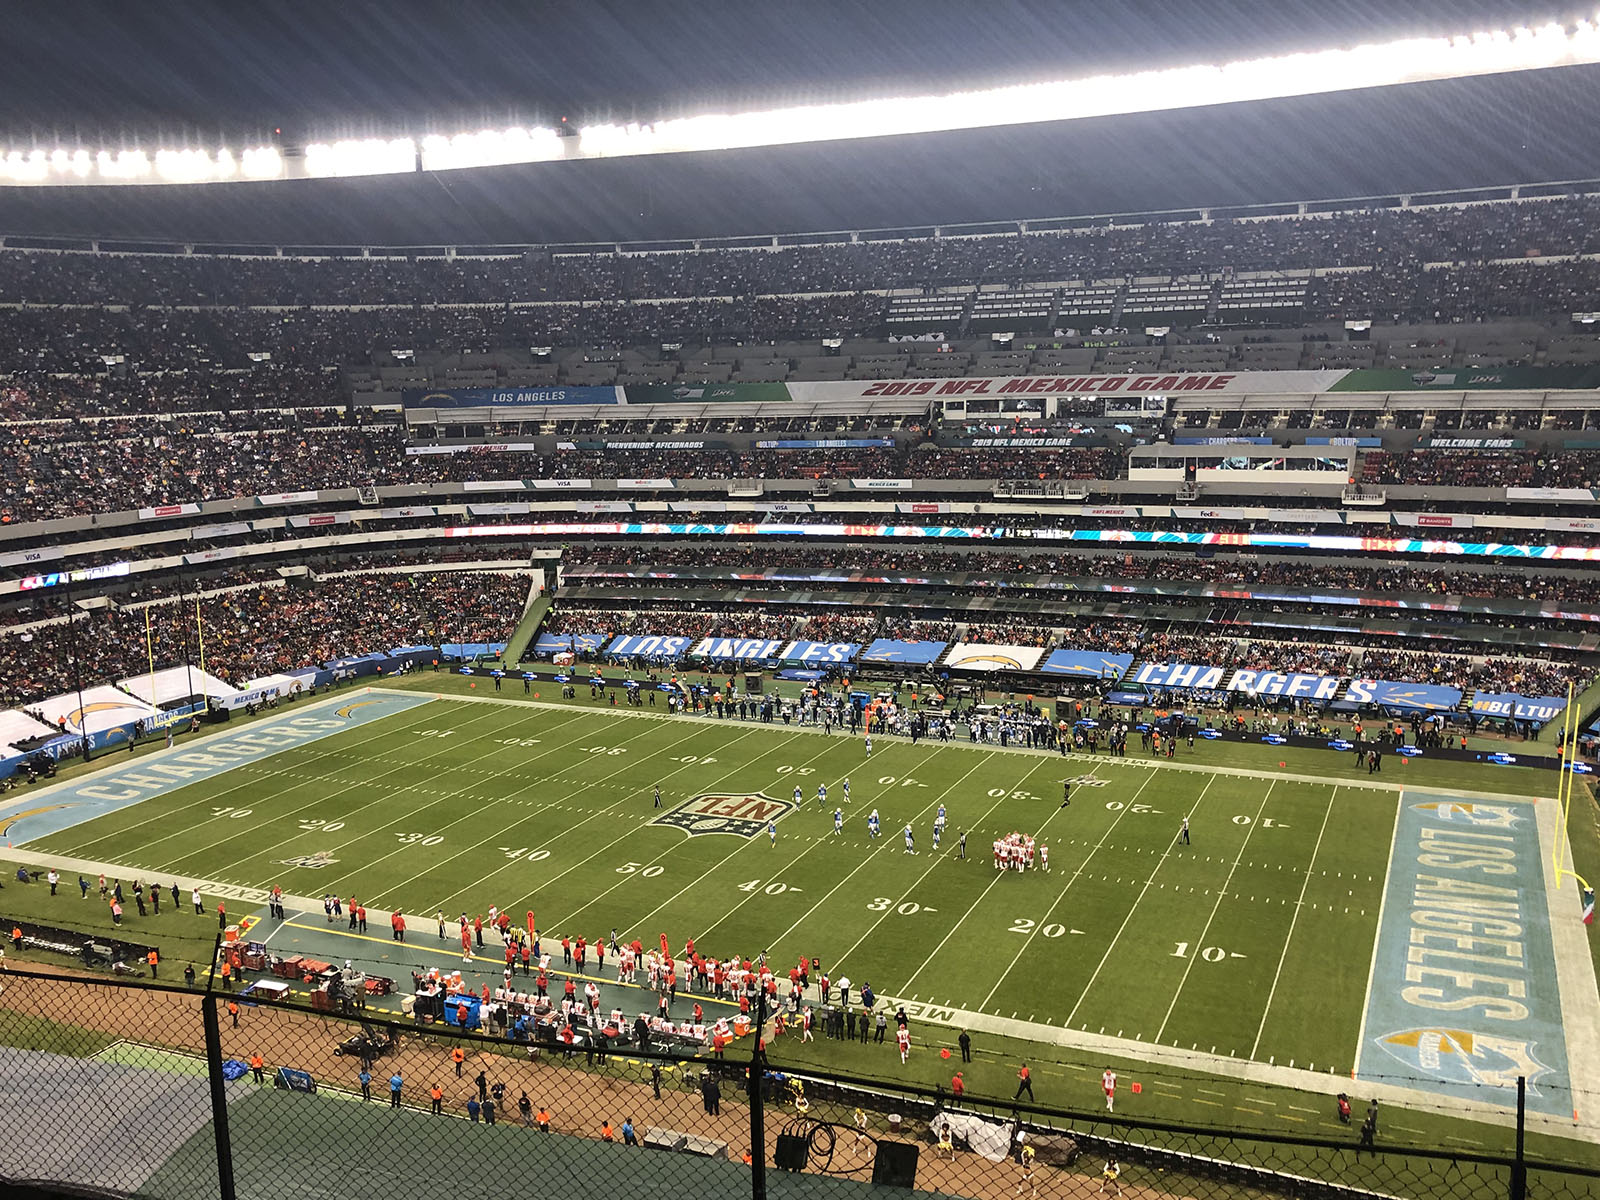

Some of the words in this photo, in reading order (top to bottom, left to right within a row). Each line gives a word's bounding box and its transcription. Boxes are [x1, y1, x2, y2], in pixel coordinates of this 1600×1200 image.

[861, 382, 937, 397] 2019
[936, 379, 993, 395] NFL
[996, 376, 1136, 394] MEXICO
[1126, 374, 1237, 392] GAME
[492, 393, 514, 403] LOS
[516, 390, 566, 402] ANGELES
[655, 441, 705, 449] AFICIONADOS
[972, 438, 992, 447] 2019
[992, 438, 1009, 447] NFL
[1009, 437, 1044, 446] MEXICO
[1043, 437, 1073, 446] GAME
[1430, 439, 1481, 448] WELCOME
[1484, 439, 1514, 448] FANS
[25, 553, 41, 561] VISA
[612, 635, 684, 654] LOS
[691, 637, 852, 662] ANGELES
[1136, 663, 1377, 702] CHARGERS
[234, 692, 260, 705] MEXICO
[143, 711, 179, 731] HARGERS
[424, 729, 456, 739] 10
[503, 738, 542, 748] 20
[588, 746, 627, 756] 30
[75, 716, 348, 801] CHARGERS
[679, 755, 718, 766] 40
[1487, 754, 1502, 762] prime
[775, 765, 816, 777] 50
[1578, 764, 1592, 772] video
[877, 776, 918, 788] 40
[987, 788, 1031, 801] 30
[214, 806, 253, 819] 10
[699, 796, 783, 822] NFL
[1105, 801, 1153, 815] 20
[301, 819, 345, 832] 20
[1231, 814, 1277, 829] 10
[398, 832, 445, 846] 30
[505, 846, 551, 862] 40
[1416, 826, 1518, 875] LOS
[615, 862, 665, 878] 50
[737, 879, 787, 895] 40
[866, 897, 920, 915] 30
[1007, 918, 1066, 938] 20
[1169, 942, 1226, 963] 10
[1400, 873, 1529, 1021] ANGELES
